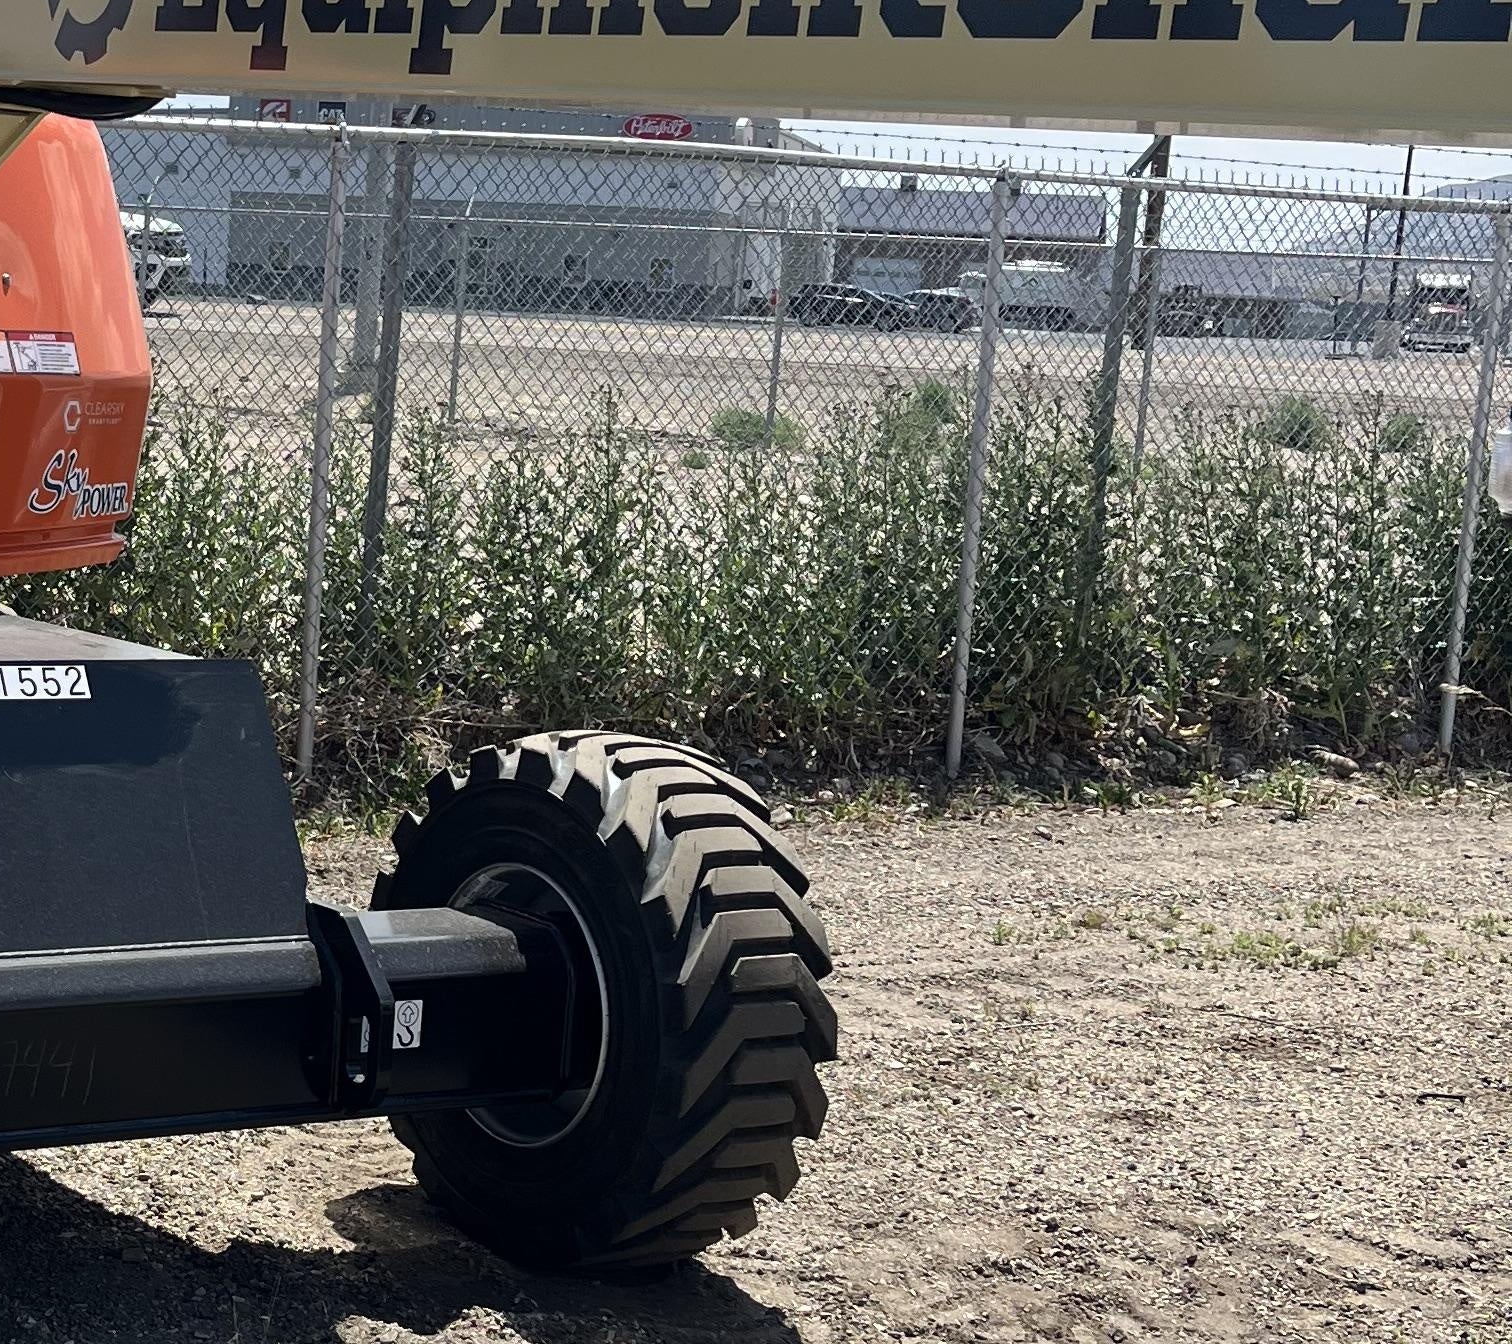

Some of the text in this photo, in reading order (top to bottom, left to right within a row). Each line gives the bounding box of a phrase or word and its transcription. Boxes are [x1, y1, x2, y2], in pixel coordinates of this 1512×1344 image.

[318, 108, 346, 122] CAT
[631, 115, 688, 136] Peterbilt
[28, 449, 89, 520] Sky
[80, 483, 128, 516] POWER
